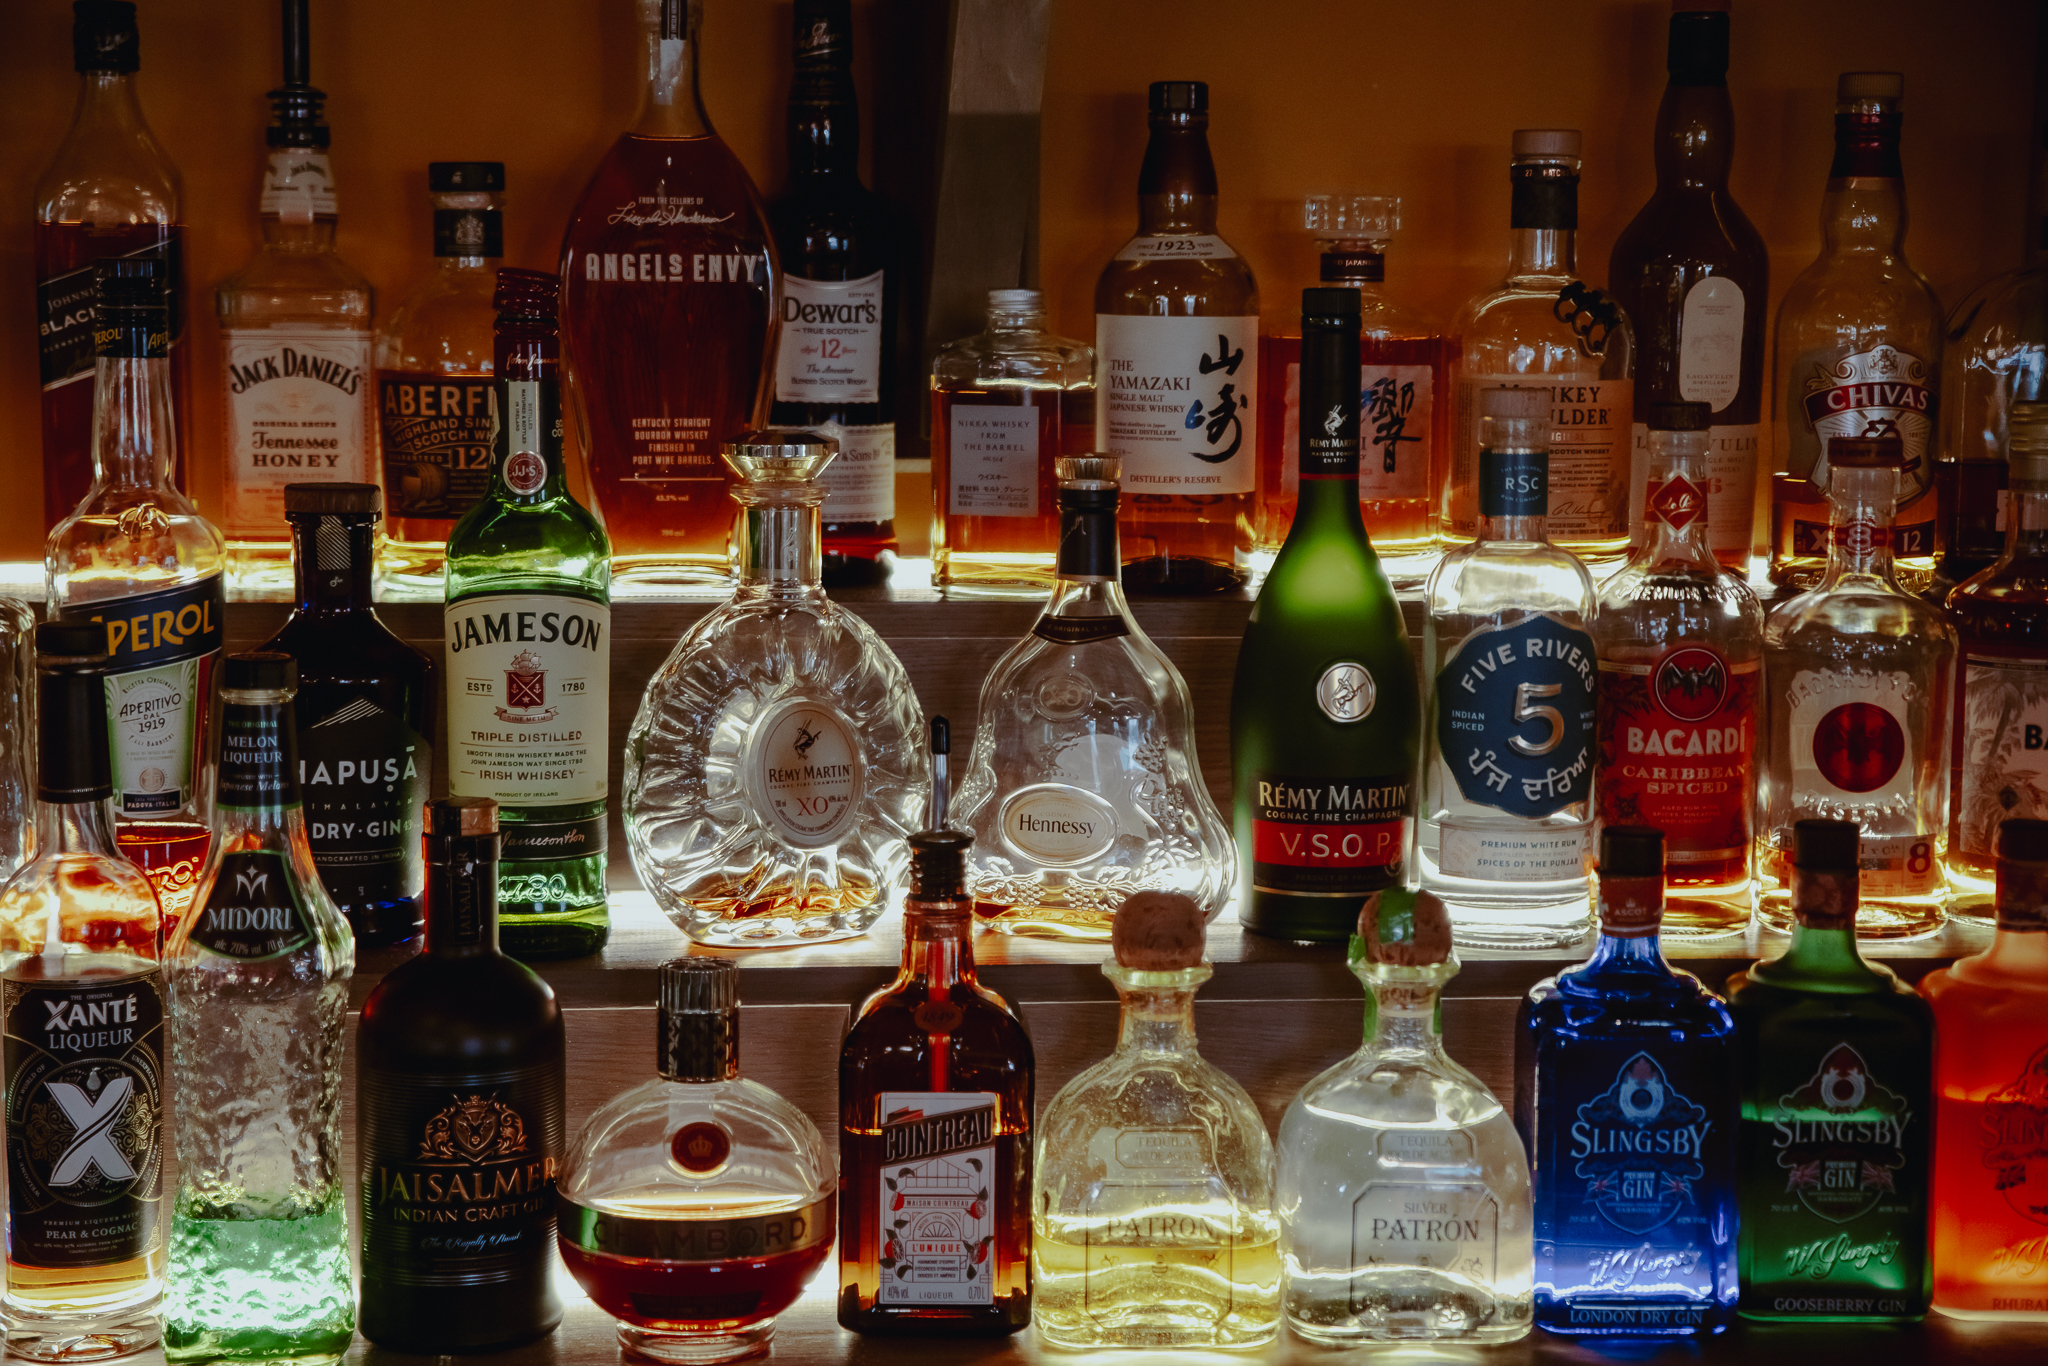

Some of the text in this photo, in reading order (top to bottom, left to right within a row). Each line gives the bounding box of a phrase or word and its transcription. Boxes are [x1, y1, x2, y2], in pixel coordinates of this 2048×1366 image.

[669, 197, 695, 205] CELLARS
[1156, 240, 1196, 251] 1923
[586, 253, 683, 282] ANGELS
[783, 297, 877, 324] Dewar's
[802, 327, 824, 335] TRUE
[821, 338, 841, 359] 12
[229, 347, 363, 396] JACK DANIEL'S
[1110, 359, 1134, 372] THE
[1110, 375, 1191, 391] YAMAZAKI
[1109, 393, 1165, 402] SINGLE MALT
[1827, 383, 1929, 411] CHIVAS
[1109, 404, 1186, 414] JAPANESE WHISKY
[674, 418, 712, 428] STRAIGHT
[958, 420, 988, 428] NIKKA
[251, 431, 339, 450] Tennessee
[413, 430, 469, 450] SCOTCH
[674, 430, 708, 440] WHISKEY
[980, 432, 1006, 440] FROM
[986, 444, 1026, 452] BARREL
[252, 454, 340, 468] HONEY
[451, 447, 488, 470] 12
[1130, 475, 1222, 484] DISTILLER'S RESERVE
[1505, 475, 1539, 494] RSC
[1902, 530, 1922, 552] 12
[90, 600, 215, 657] PEROL
[452, 612, 602, 653] JAMESON
[1461, 638, 1595, 695] FIVE RIVERS
[561, 682, 586, 692] 1780
[120, 692, 182, 718] APERITIVO
[143, 712, 160, 720] DAL
[1452, 710, 1485, 720] INDIAN
[1508, 682, 1565, 757] 5
[138, 718, 166, 733] 1919
[241, 720, 278, 728] ORIGINAL
[1452, 720, 1485, 732] SPICED
[227, 735, 278, 748] MELON
[471, 730, 582, 743] TRIPLE DISTILLED
[223, 750, 283, 765] LIQUEUR
[466, 749, 492, 758] SMOOTH
[494, 751, 515, 759] IRISH
[554, 750, 574, 758] MADE
[576, 748, 588, 756] THE
[470, 758, 487, 766] JOHN
[488, 759, 524, 767] JAMESON
[568, 758, 584, 766] 1780
[479, 768, 576, 781] IRISH WHISKEY
[768, 764, 851, 784] RÉMY MARTIN
[1622, 764, 1746, 781] CARIBBEAN
[814, 778, 850, 786] CHAMPAGNE
[1646, 781, 1729, 796] SPICED
[1258, 780, 1407, 811] RÉMY MARTIN
[796, 796, 828, 816] XO
[1266, 810, 1401, 822] COGNAC FINE CHAMPAGNE
[312, 819, 401, 840] DRY GIN
[1018, 813, 1096, 839] Hennessy
[1482, 840, 1576, 849] PREMIUM WHITE RUM
[1478, 858, 1578, 868] SPICES OF THE PUNJAB
[1907, 842, 1931, 874] 8
[206, 906, 294, 933] MIDORI
[86, 992, 114, 1000] ORIGINAL
[44, 992, 138, 1031] XANTÉ
[50, 1028, 134, 1053] LIQUEUR
[886, 1110, 994, 1162] COINTREAU
[1772, 1110, 1914, 1150] SLINGSBY
[1136, 1136, 1192, 1148] TEQUILA
[1398, 1136, 1453, 1147] TEQUILA
[1570, 1120, 1714, 1160] SLINGSBY
[378, 1156, 556, 1205] JAISALMER
[1824, 1168, 1856, 1188] GIN
[1622, 1180, 1654, 1199] GIN
[394, 1199, 549, 1223] INDIAN CRAFT GIN
[1404, 1202, 1448, 1214] SILVER
[84, 1216, 120, 1226] LIQUEUR
[46, 1222, 138, 1240] PEAR & COGNAC
[912, 1244, 960, 1254] L'UNIQUE
[1774, 1297, 1906, 1314] GOOSEBERRY GIN
[1570, 1310, 1704, 1324] LONDON DRY GIN
